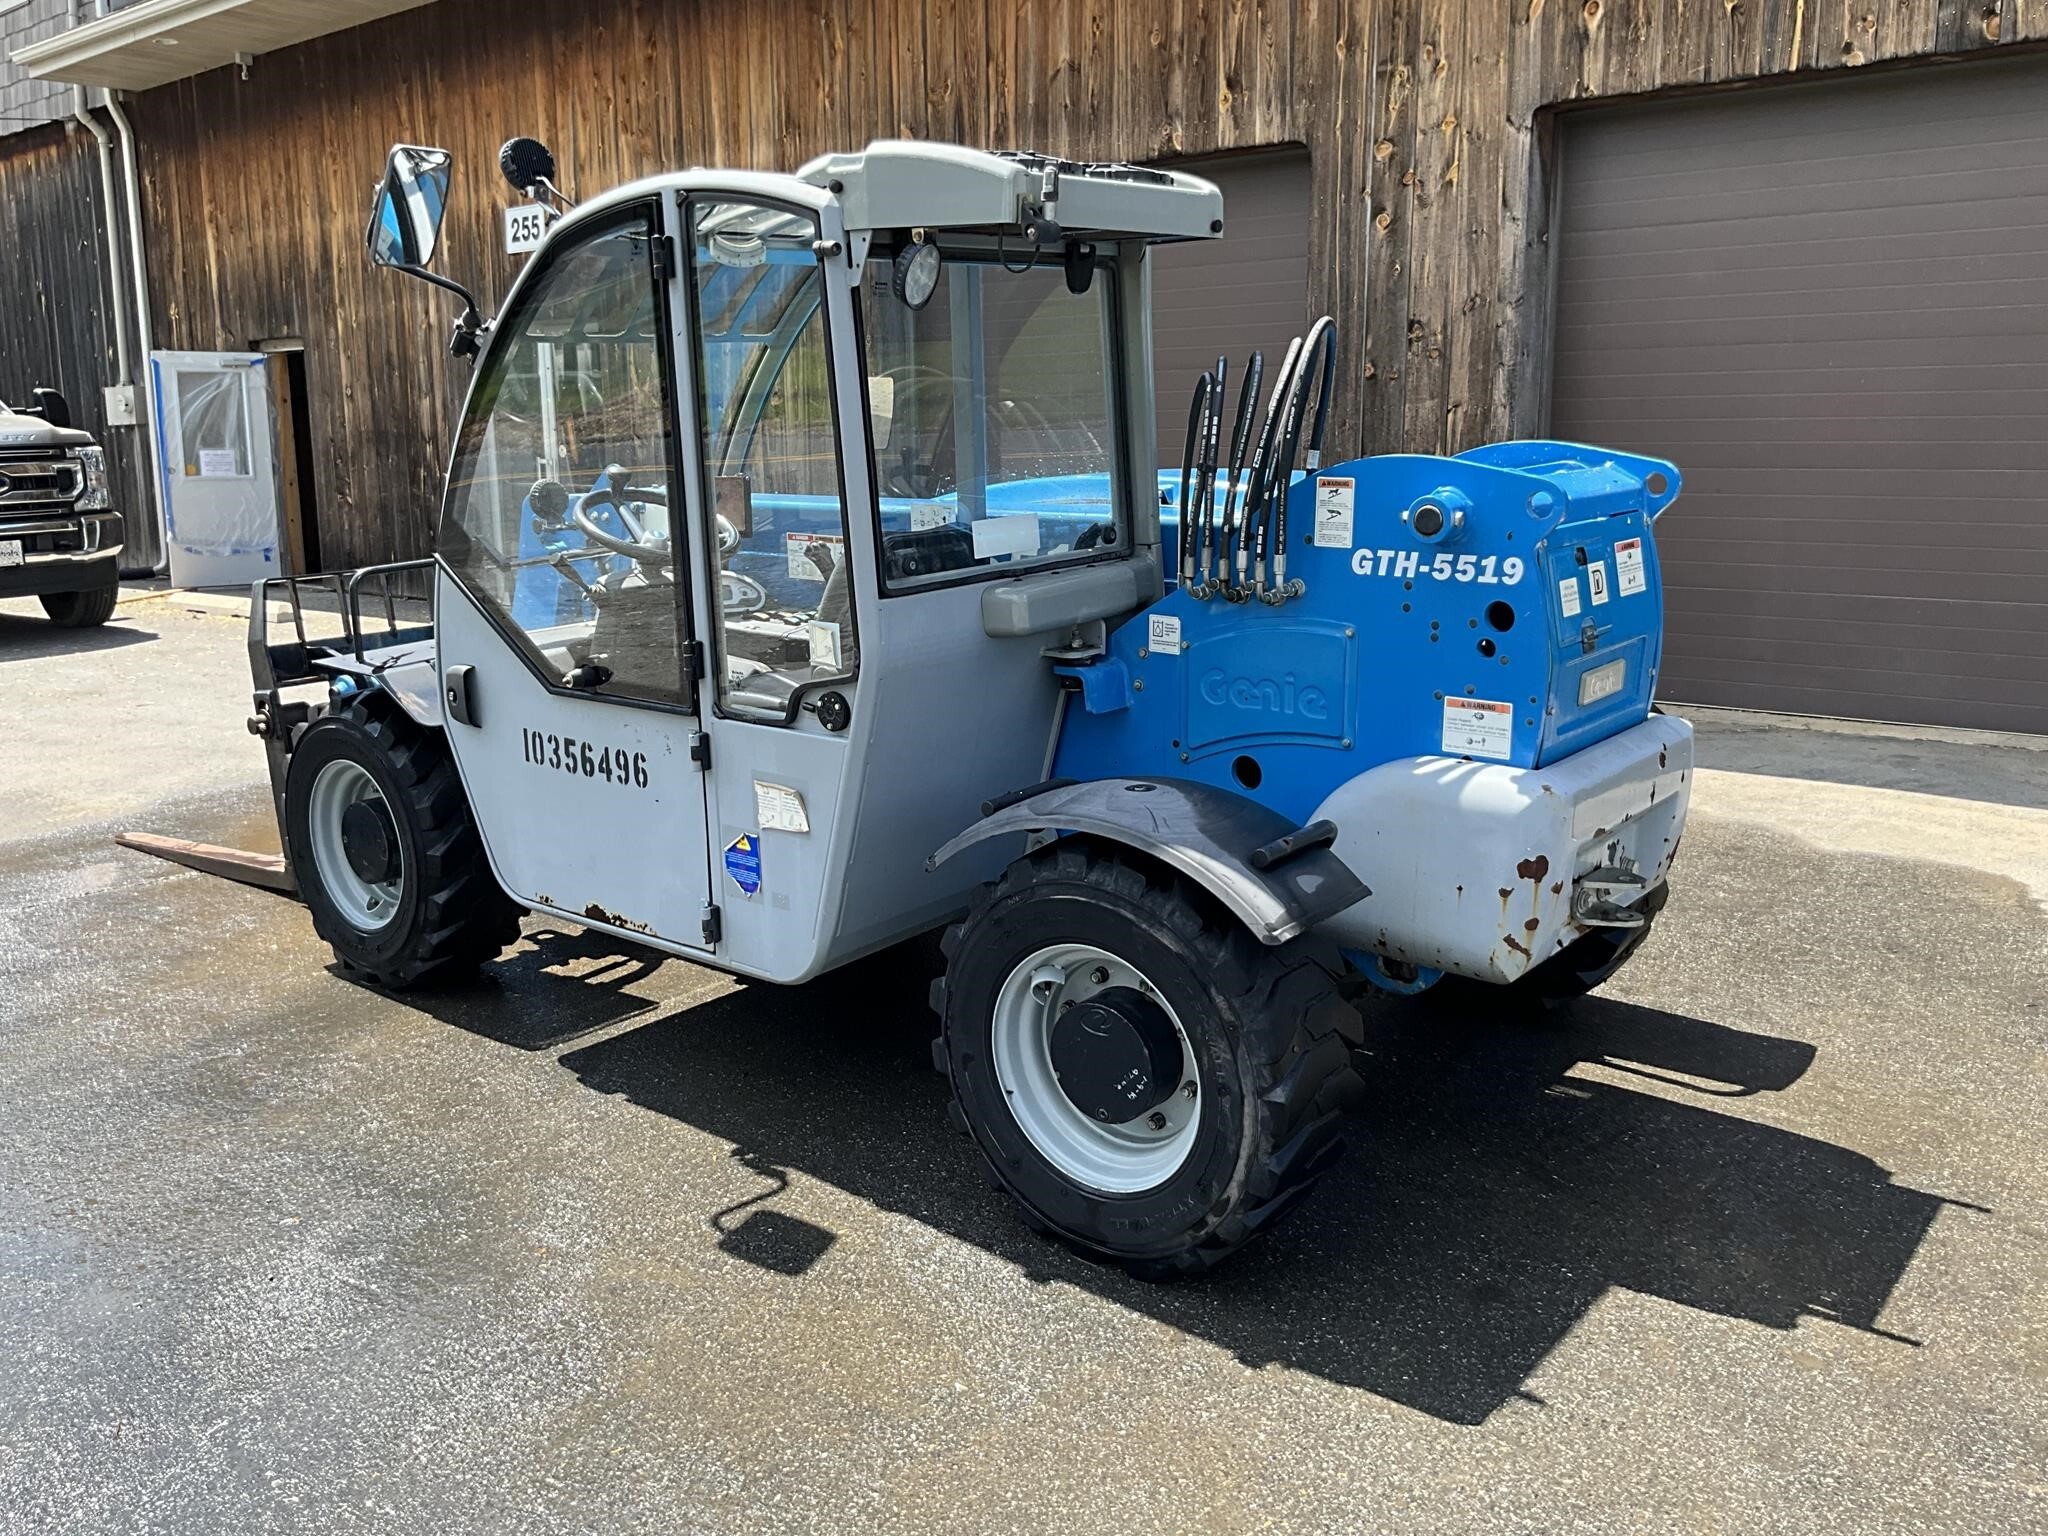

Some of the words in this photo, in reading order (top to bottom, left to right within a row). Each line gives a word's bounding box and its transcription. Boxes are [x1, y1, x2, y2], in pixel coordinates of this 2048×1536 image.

[511, 214, 541, 243] 255
[1351, 547, 1525, 586] GTH-5519
[1200, 666, 1328, 720] Genie
[1466, 700, 1496, 712] WARNING
[522, 727, 649, 789] 10356496
